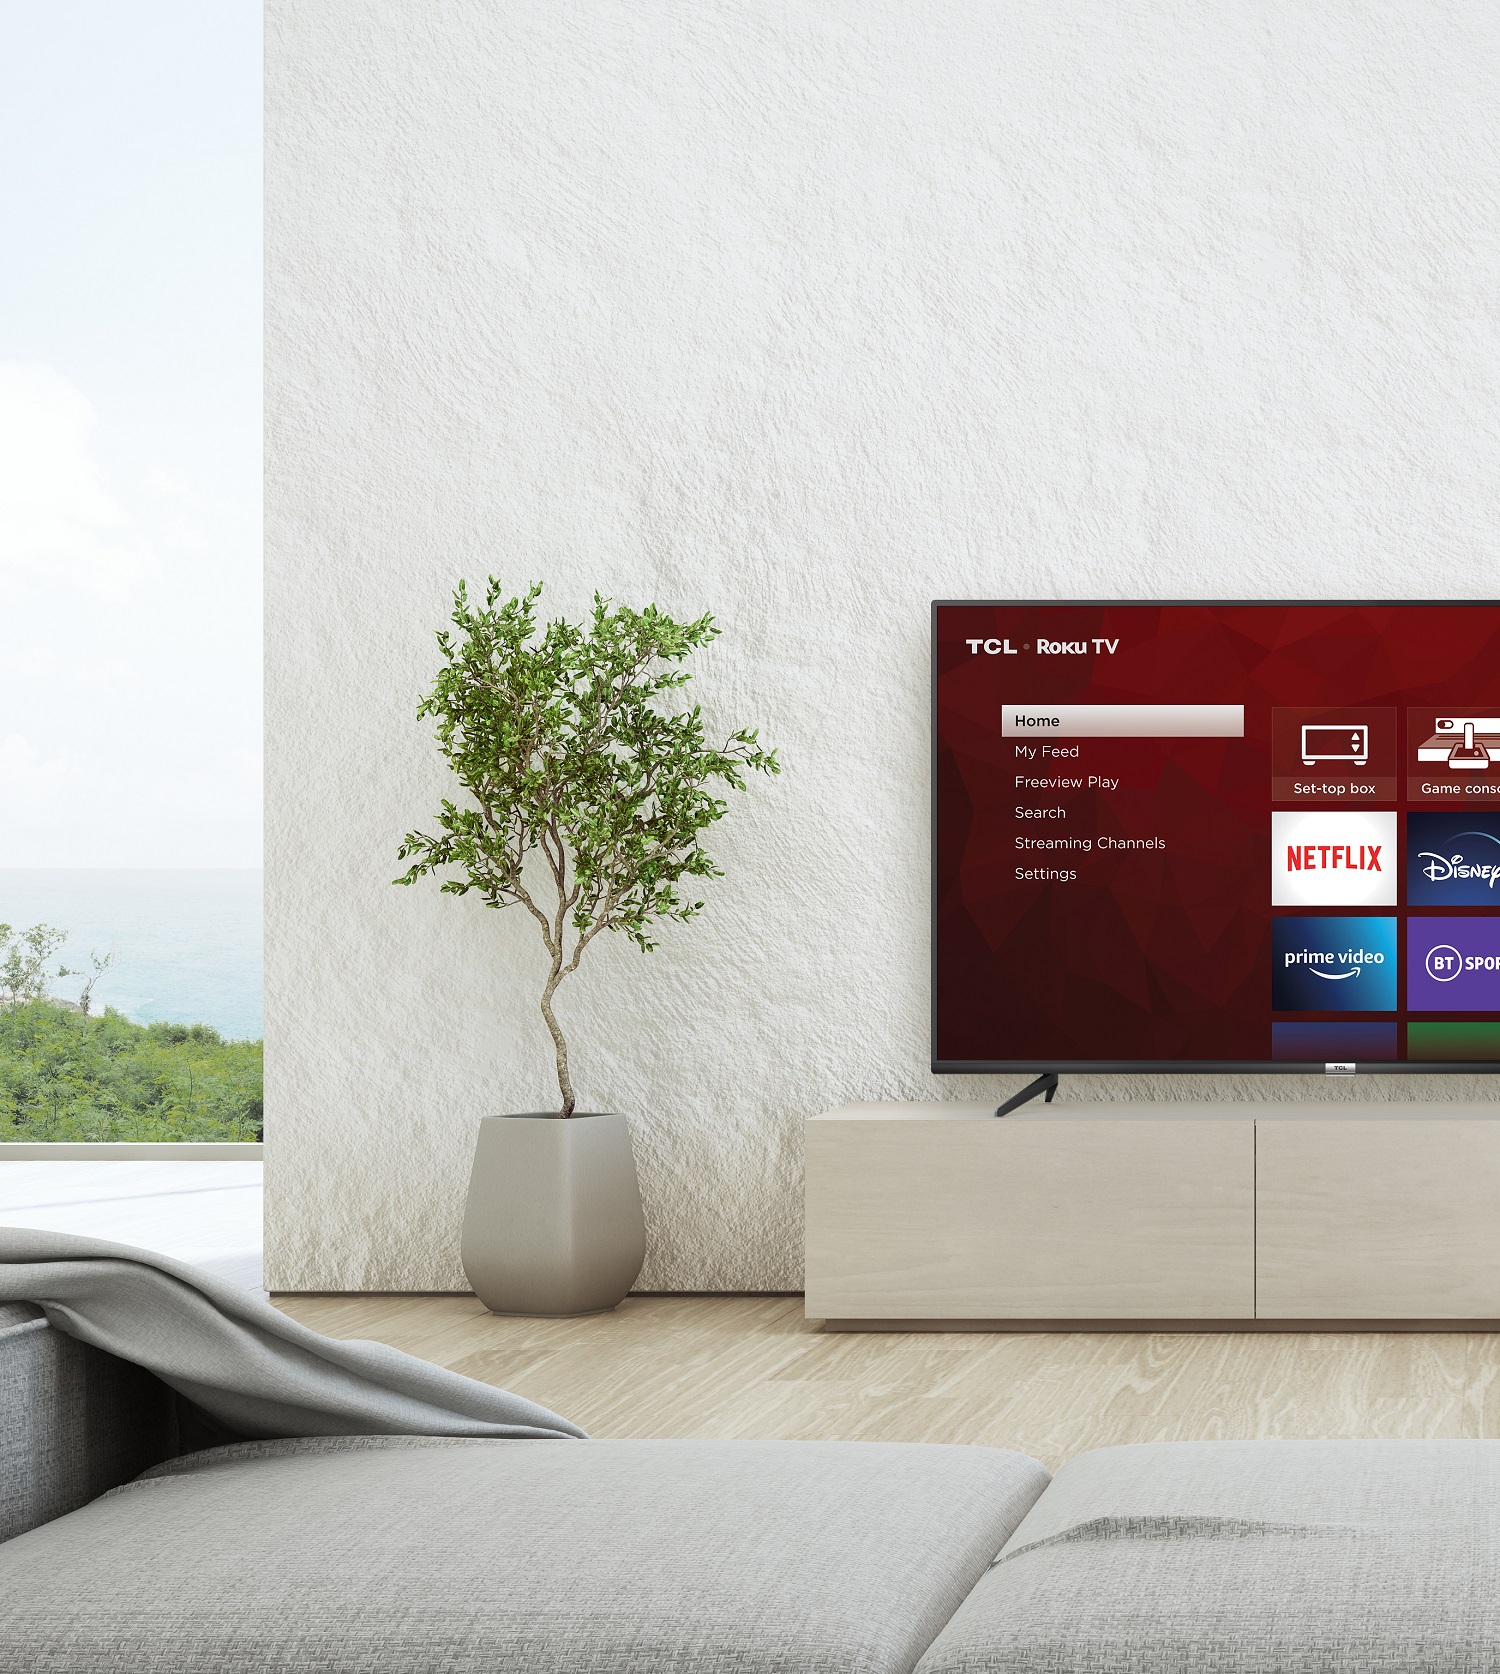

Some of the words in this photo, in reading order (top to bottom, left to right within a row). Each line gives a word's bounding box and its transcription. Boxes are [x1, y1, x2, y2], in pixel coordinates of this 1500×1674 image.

[965, 638, 1018, 655] TCL
[1036, 638, 1087, 655] Roku
[1091, 638, 1120, 655] TV
[1015, 714, 1060, 727] Home
[1015, 745, 1037, 760] My
[1042, 745, 1079, 758] Feed
[1015, 775, 1083, 789] Freeview
[1088, 775, 1120, 791] Play
[1293, 782, 1346, 796] Set-top
[1350, 782, 1376, 794] box
[1421, 782, 1461, 794] Game
[1015, 806, 1066, 819] Search
[1015, 836, 1092, 852] Streaming
[1097, 836, 1166, 850] Channels
[1287, 845, 1382, 872] NETFLIX
[1015, 867, 1077, 882] Settings
[1285, 948, 1335, 968] prime
[1337, 948, 1385, 964] video
[1434, 956, 1455, 970] BT
